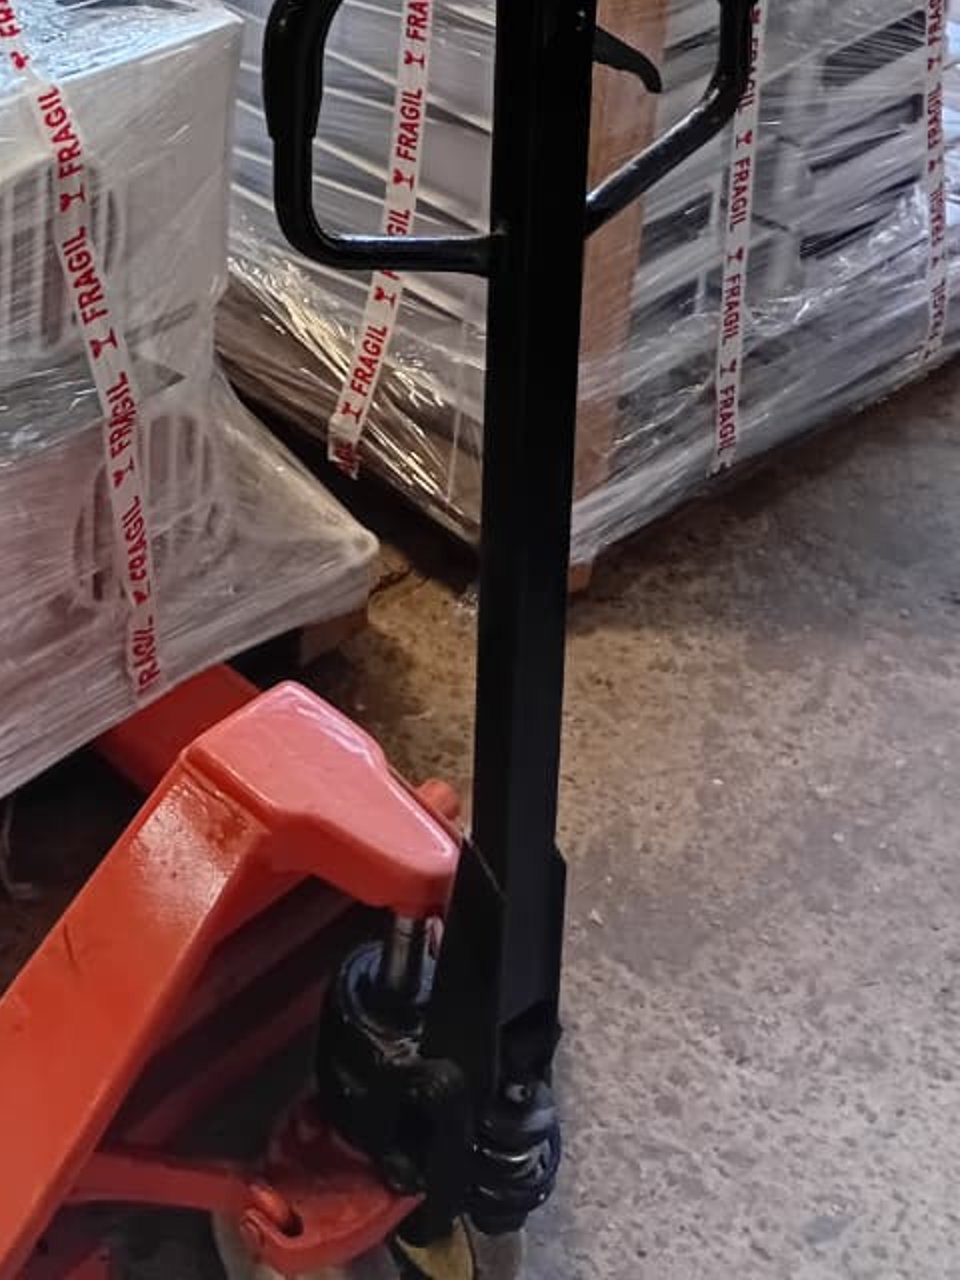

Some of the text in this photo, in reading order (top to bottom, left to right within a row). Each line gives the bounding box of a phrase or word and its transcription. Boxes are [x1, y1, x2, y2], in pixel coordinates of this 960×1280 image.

[397, 88, 424, 161] FRAGIL
[37, 86, 86, 181] FRAGIL
[63, 226, 110, 326] FRAGIL
[729, 157, 750, 232] FRAGIL
[722, 274, 742, 345] FRAGIL
[350, 325, 388, 396] FRAGIL
[719, 384, 736, 455] FRAGIL
